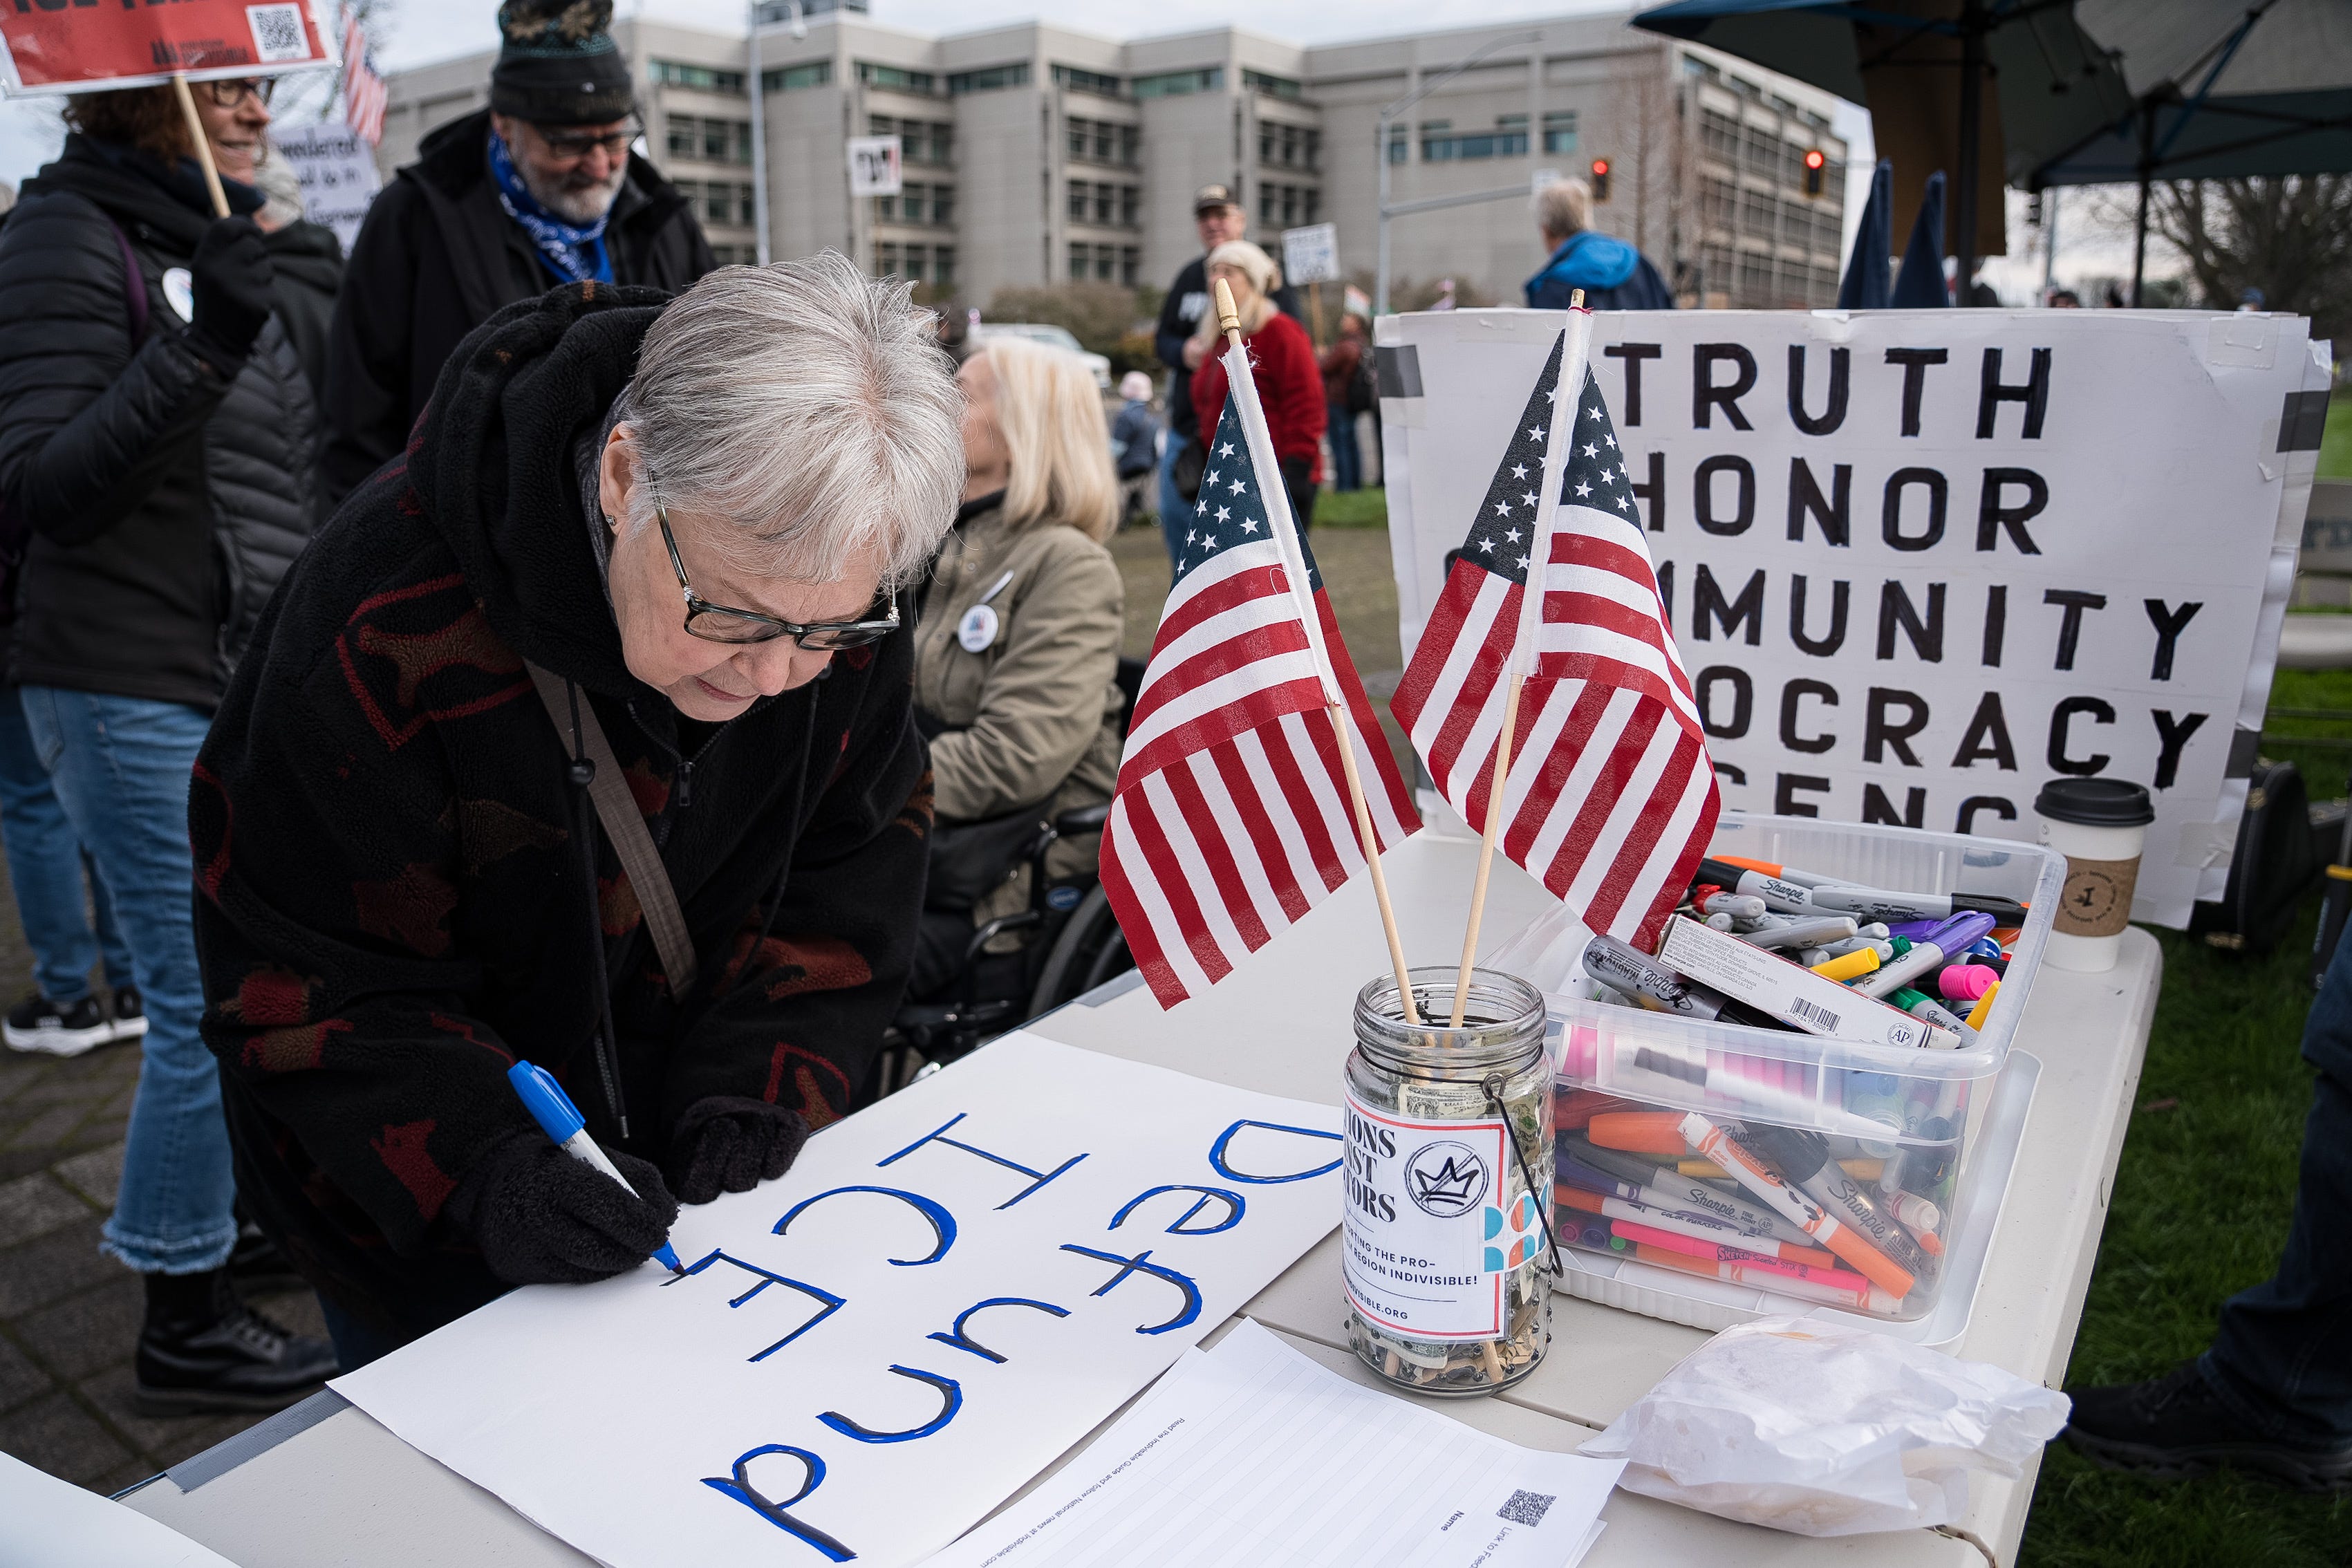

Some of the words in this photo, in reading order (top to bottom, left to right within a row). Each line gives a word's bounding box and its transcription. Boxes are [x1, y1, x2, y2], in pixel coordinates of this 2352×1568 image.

[1603, 342, 2053, 440] TRUTH
[1695, 666, 2208, 790] OCRACY
[1793, 1013, 1811, 1025] 71641
[1811, 1021, 1830, 1033] 30001
[1891, 1029, 1910, 1043] AP
[1345, 1102, 1396, 1158] IONS
[1345, 1137, 1377, 1184] NST
[1344, 1167, 1396, 1222] TORS
[1661, 1211, 1684, 1221] COLOR
[1686, 1218, 1722, 1231] MARKERS
[1354, 1247, 1386, 1276] REGION
[1390, 1269, 1477, 1285] INDIVISIBLE!
[1375, 1247, 1396, 1262] THE
[1401, 1256, 1435, 1268] PRO-
[1753, 1254, 1777, 1266] Scented
[1168, 1417, 1185, 1431] Read
[1157, 1430, 1169, 1440] the
[1130, 1438, 1159, 1462] Indivisible
[1112, 1460, 1132, 1475] Guide
[1099, 1473, 1112, 1485] and
[1081, 1484, 1101, 1499] follow
[1055, 1497, 1083, 1518] National
[1038, 1515, 1056, 1530] news
[1441, 1510, 1465, 1531] Name
[1029, 1526, 1038, 1536] at
[1494, 1527, 1513, 1542] Link
[980, 1533, 1032, 1568] Indivisible.com
[1487, 1542, 1499, 1551] to
